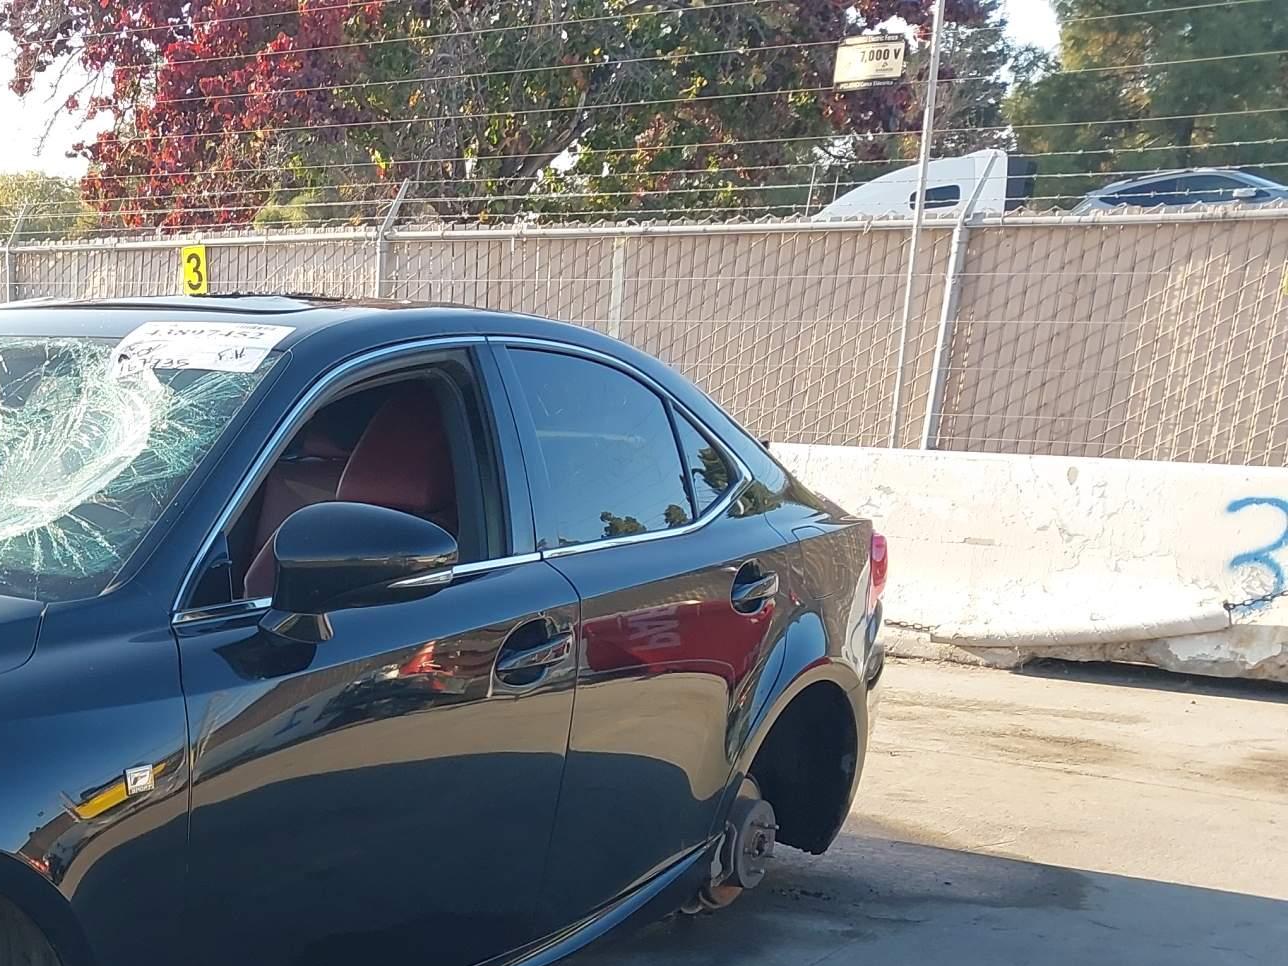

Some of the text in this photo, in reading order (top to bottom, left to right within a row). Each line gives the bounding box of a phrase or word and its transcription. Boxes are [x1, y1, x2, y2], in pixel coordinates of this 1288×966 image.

[860, 48, 902, 63] 7,000 V
[186, 252, 203, 291] 3
